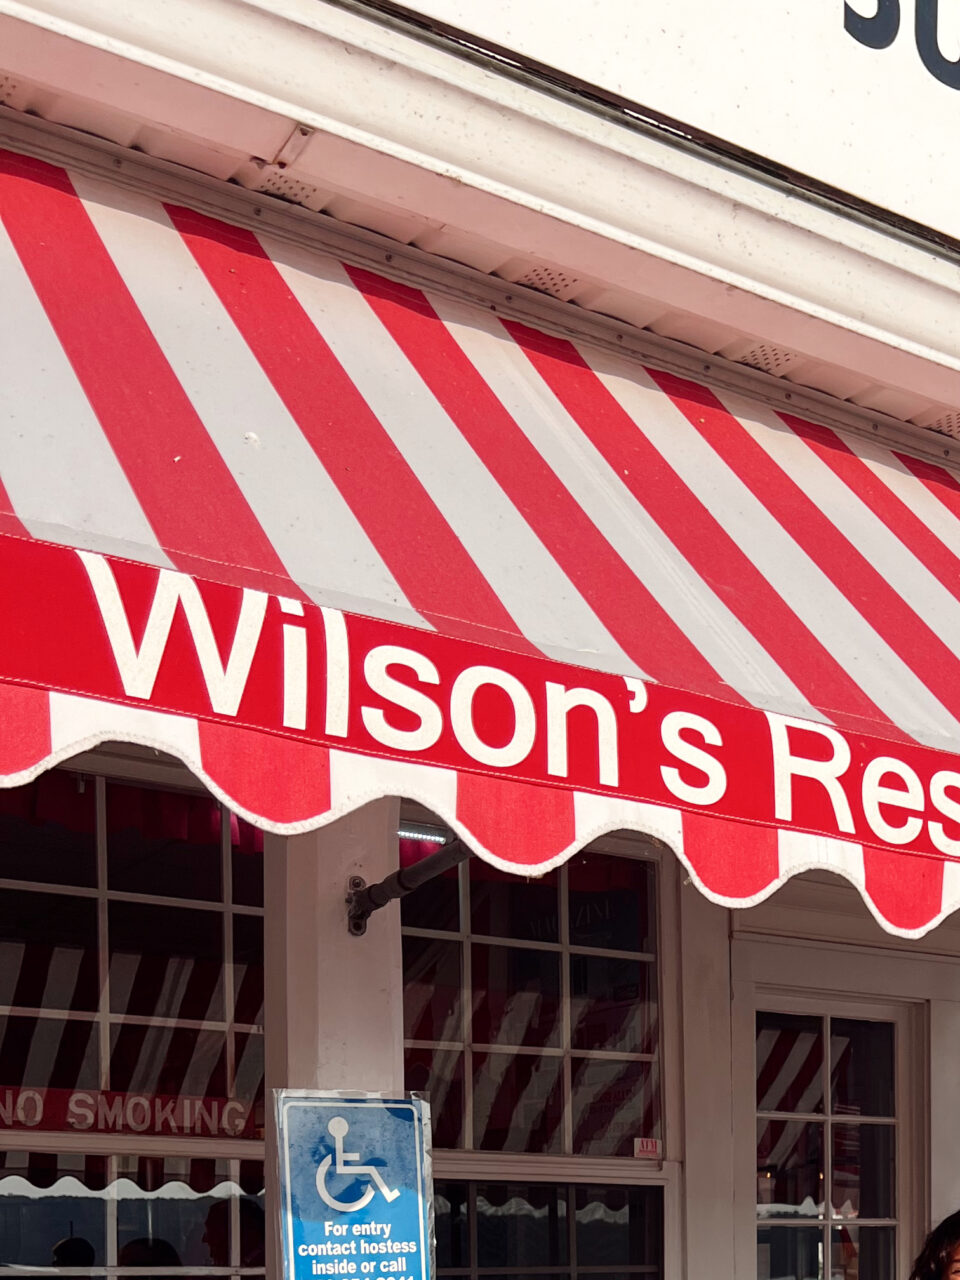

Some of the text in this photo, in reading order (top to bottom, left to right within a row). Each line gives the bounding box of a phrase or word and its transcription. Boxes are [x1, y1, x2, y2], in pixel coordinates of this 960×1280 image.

[76, 549, 727, 806] Wilson's
[67, 1093, 246, 1137] SMOKING
[324, 1221, 391, 1239] For entry
[298, 1239, 417, 1256] contact hostess
[312, 1257, 407, 1275] inside or call
